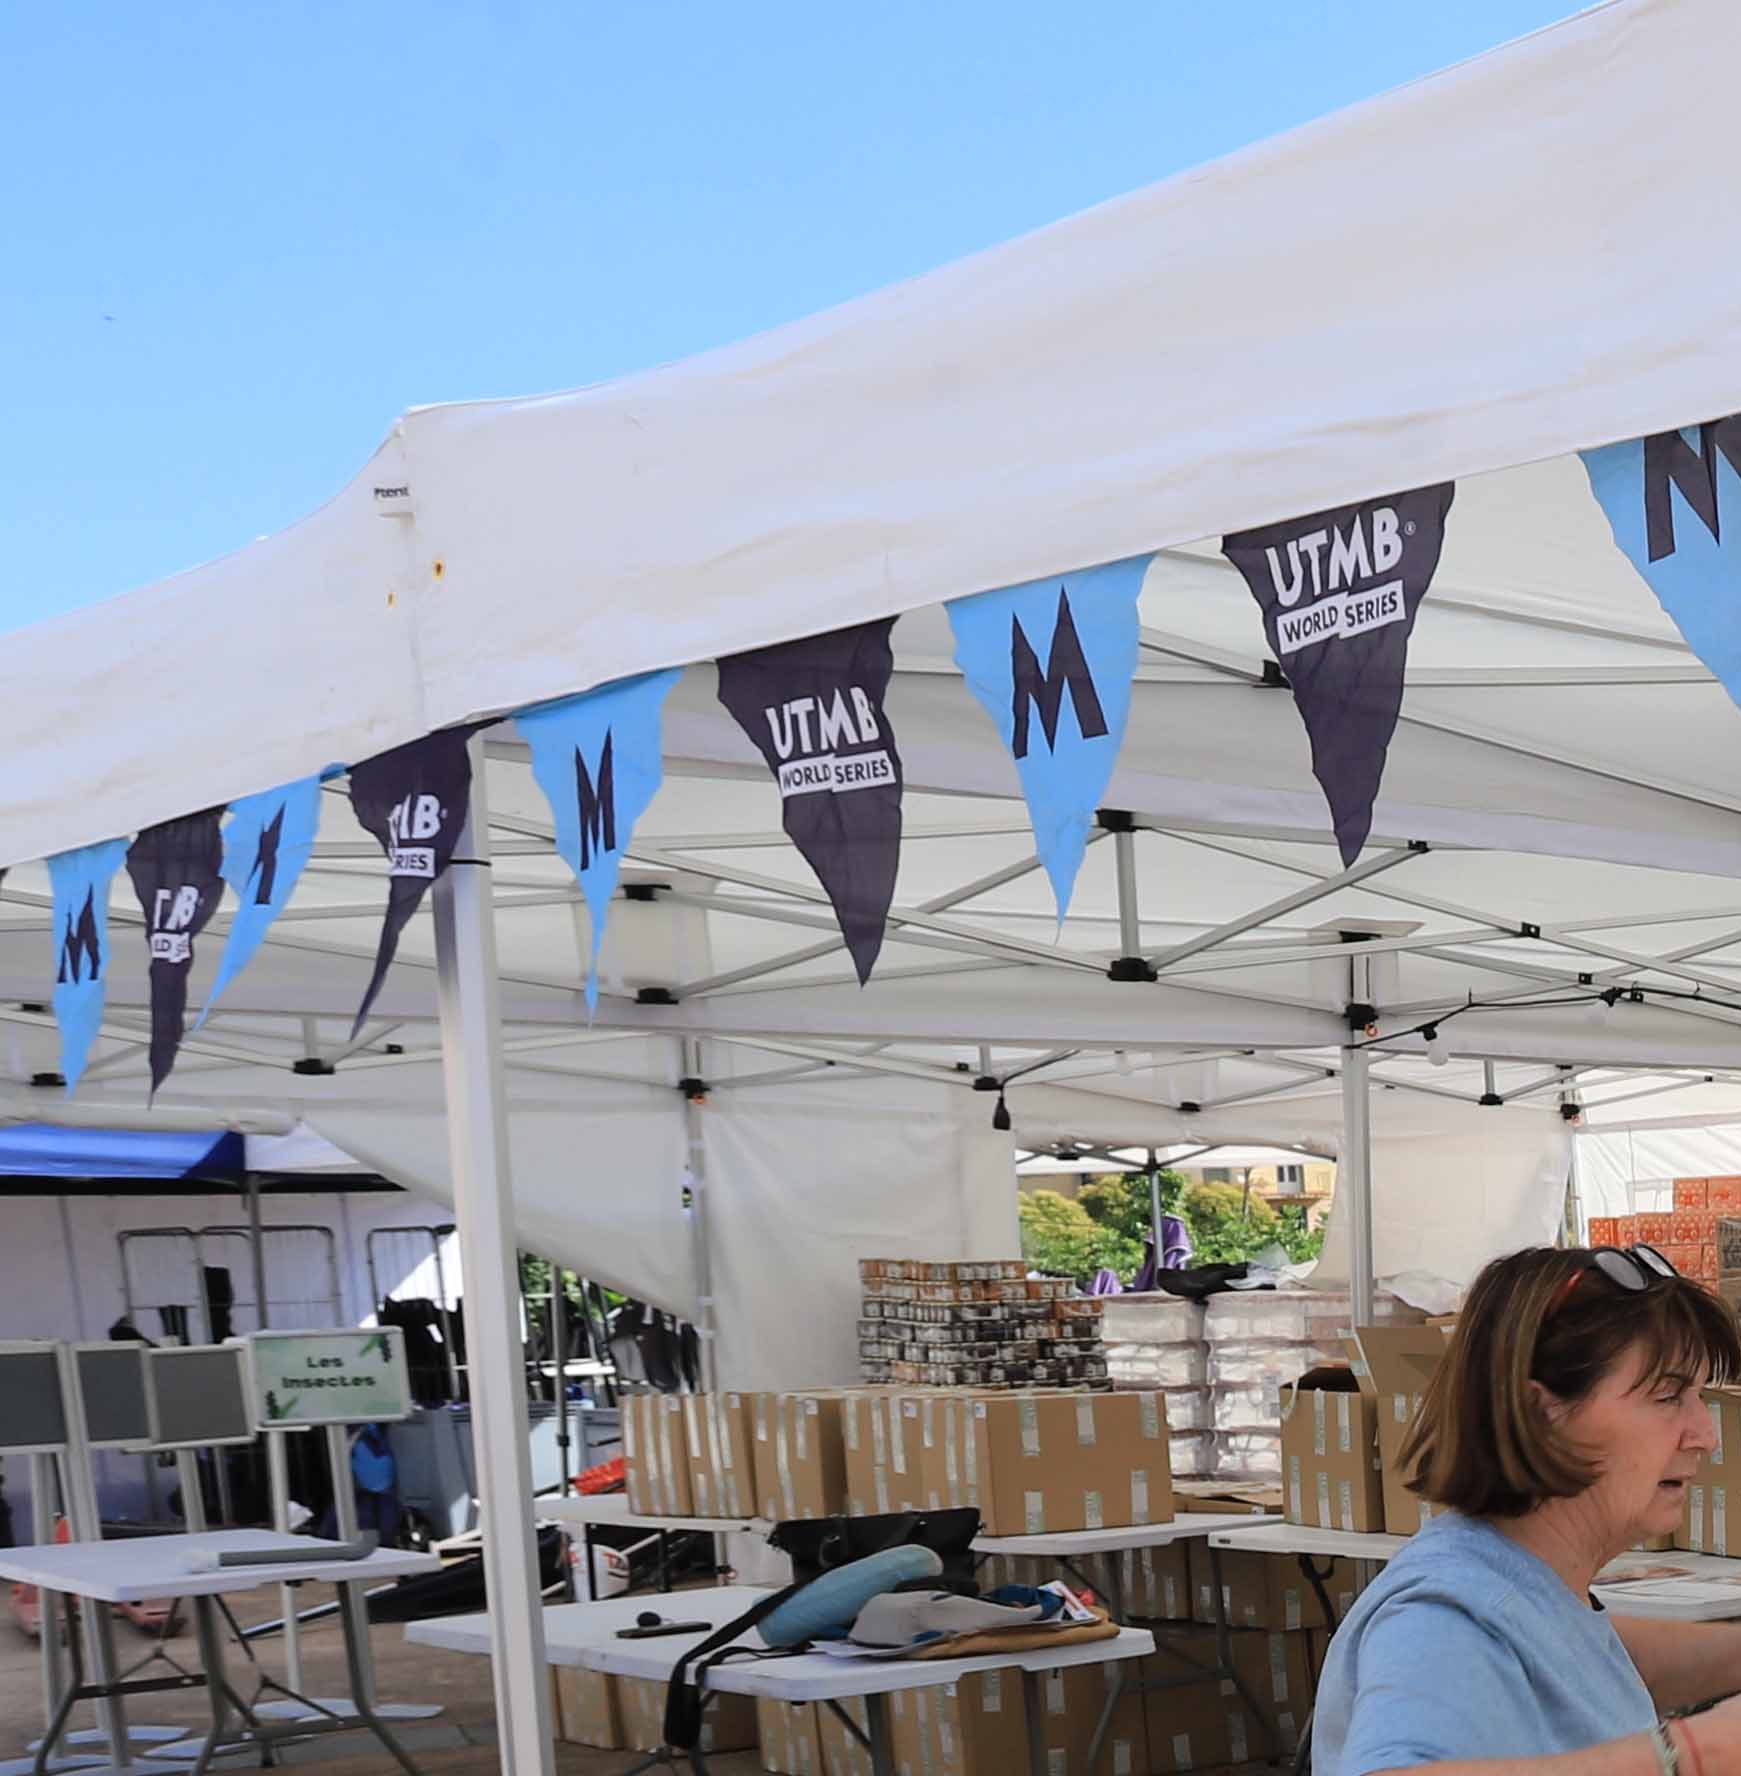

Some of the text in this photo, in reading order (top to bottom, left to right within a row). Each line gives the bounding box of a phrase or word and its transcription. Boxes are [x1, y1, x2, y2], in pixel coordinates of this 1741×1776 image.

[1265, 507, 1404, 608] UTMB
[1282, 591, 1399, 644] WORLD SERIES
[1012, 583, 1110, 760] M
[765, 686, 881, 760] UTMB
[575, 721, 616, 871] M
[833, 760, 890, 784] SERIES
[282, 1376, 377, 1390] Insectes
[307, 1357, 344, 1369] Les
